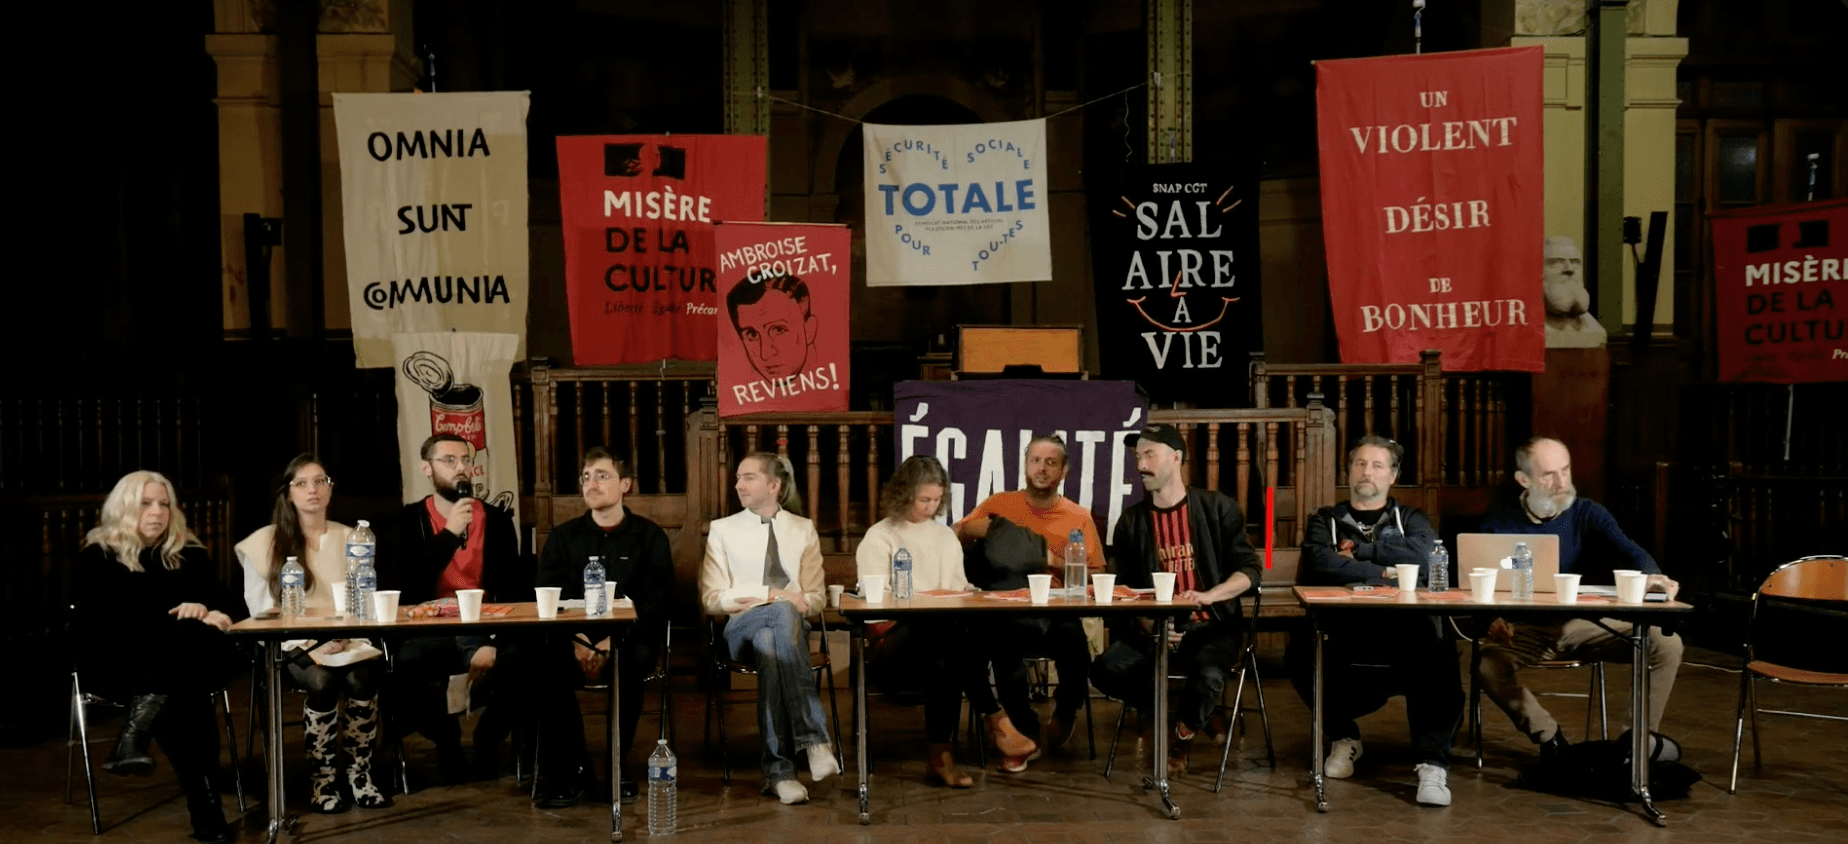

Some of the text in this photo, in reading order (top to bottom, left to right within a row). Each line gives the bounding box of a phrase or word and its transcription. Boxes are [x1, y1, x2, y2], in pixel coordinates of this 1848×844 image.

[1419, 91, 1448, 108] UN
[367, 128, 490, 162] OMNIA
[1350, 117, 1517, 154] VIOLENT
[879, 139, 1030, 174] SÉCURITÉ SOCIALE
[604, 185, 711, 223] MISÈRE
[878, 179, 1036, 217] TOTALE
[1153, 183, 1207, 193] SNAP CGT
[397, 204, 472, 235] SUNT
[1136, 200, 1222, 240] SAL
[1383, 196, 1491, 234] DÉSIR
[605, 227, 689, 254] DE LA
[720, 236, 808, 274] AMBROISE
[895, 225, 930, 256] POUR
[747, 253, 837, 284] CROIZAT,
[1122, 249, 1235, 290] AIRE
[1429, 278, 1452, 293] DE
[1361, 299, 1528, 332] BONHEUR
[1748, 288, 1835, 315] DE LA
[1745, 320, 1844, 345] CULTU
[1141, 331, 1222, 369] VIE
[733, 362, 839, 405] REVIENS!
